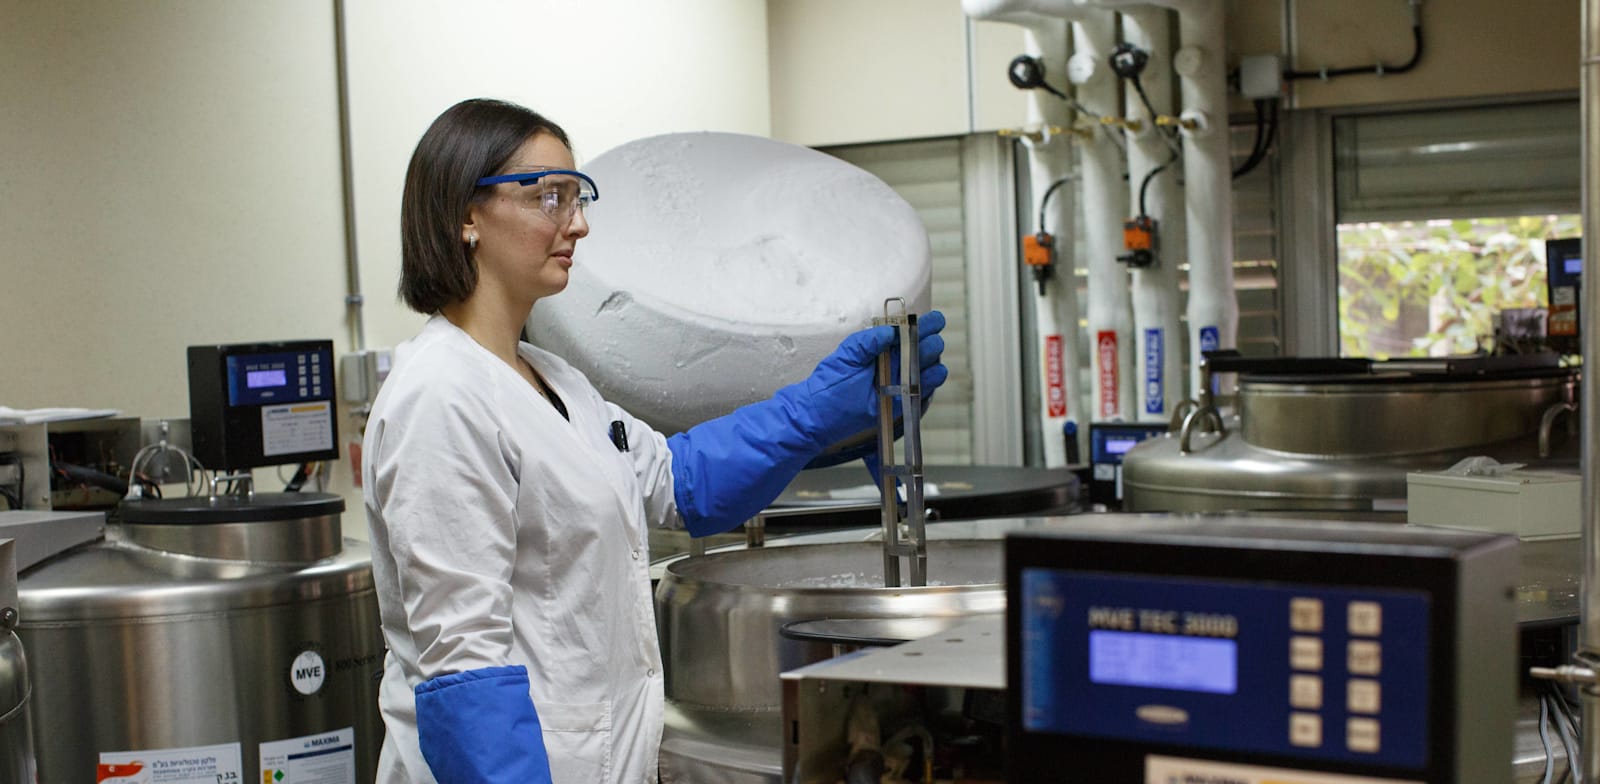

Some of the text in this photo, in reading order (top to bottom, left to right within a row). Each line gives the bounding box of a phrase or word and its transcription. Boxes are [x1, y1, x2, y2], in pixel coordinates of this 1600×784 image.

[1088, 606, 1135, 630] MVE
[1139, 609, 1178, 633] TEC
[296, 666, 320, 680] MVE
